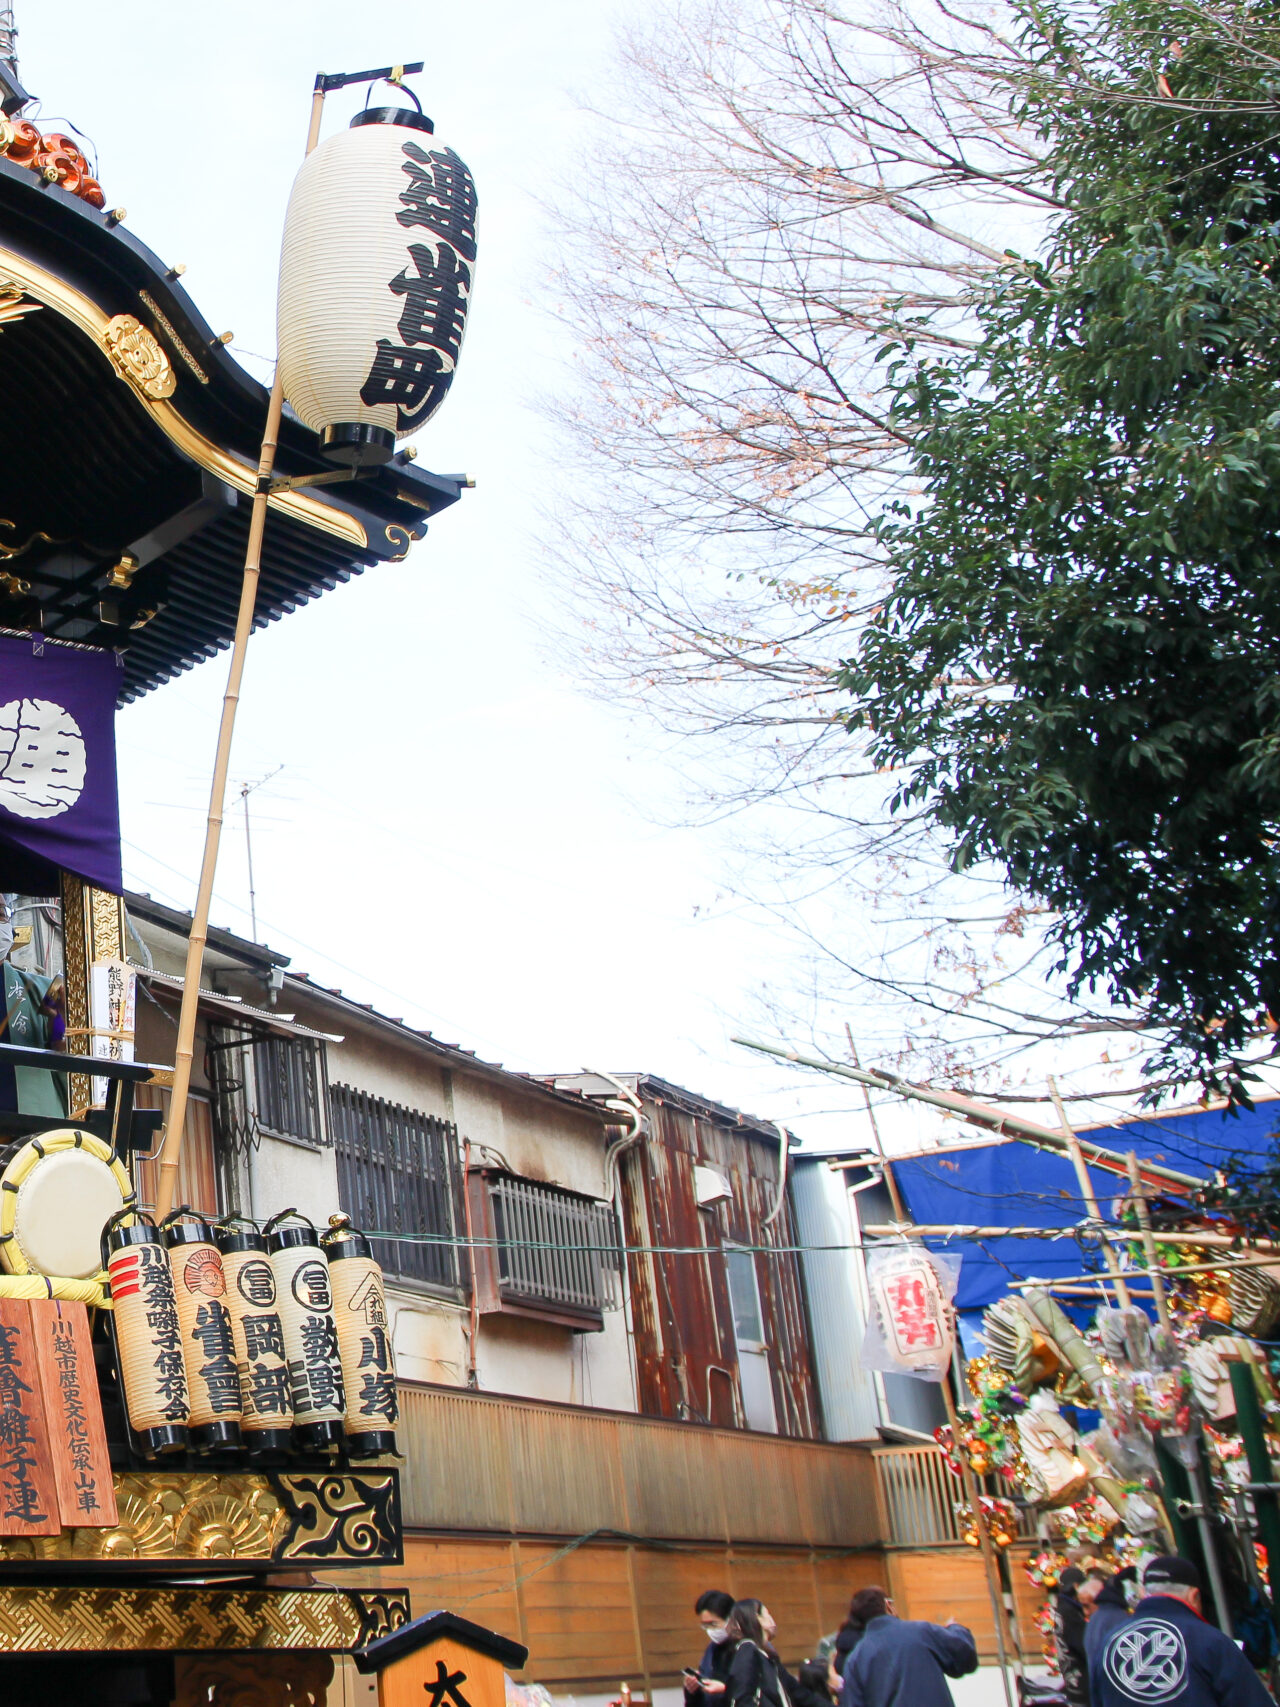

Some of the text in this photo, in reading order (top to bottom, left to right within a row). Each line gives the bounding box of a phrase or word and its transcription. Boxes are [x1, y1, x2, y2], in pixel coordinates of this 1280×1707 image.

[359, 141, 479, 431] 連雀町
[50, 1319, 101, 1512] 川越市歴史文化伝承山車
[140, 1245, 191, 1422] 川越祭囃子保存会
[240, 1312, 293, 1416] 岡部
[357, 1326, 399, 1424] 小塚
